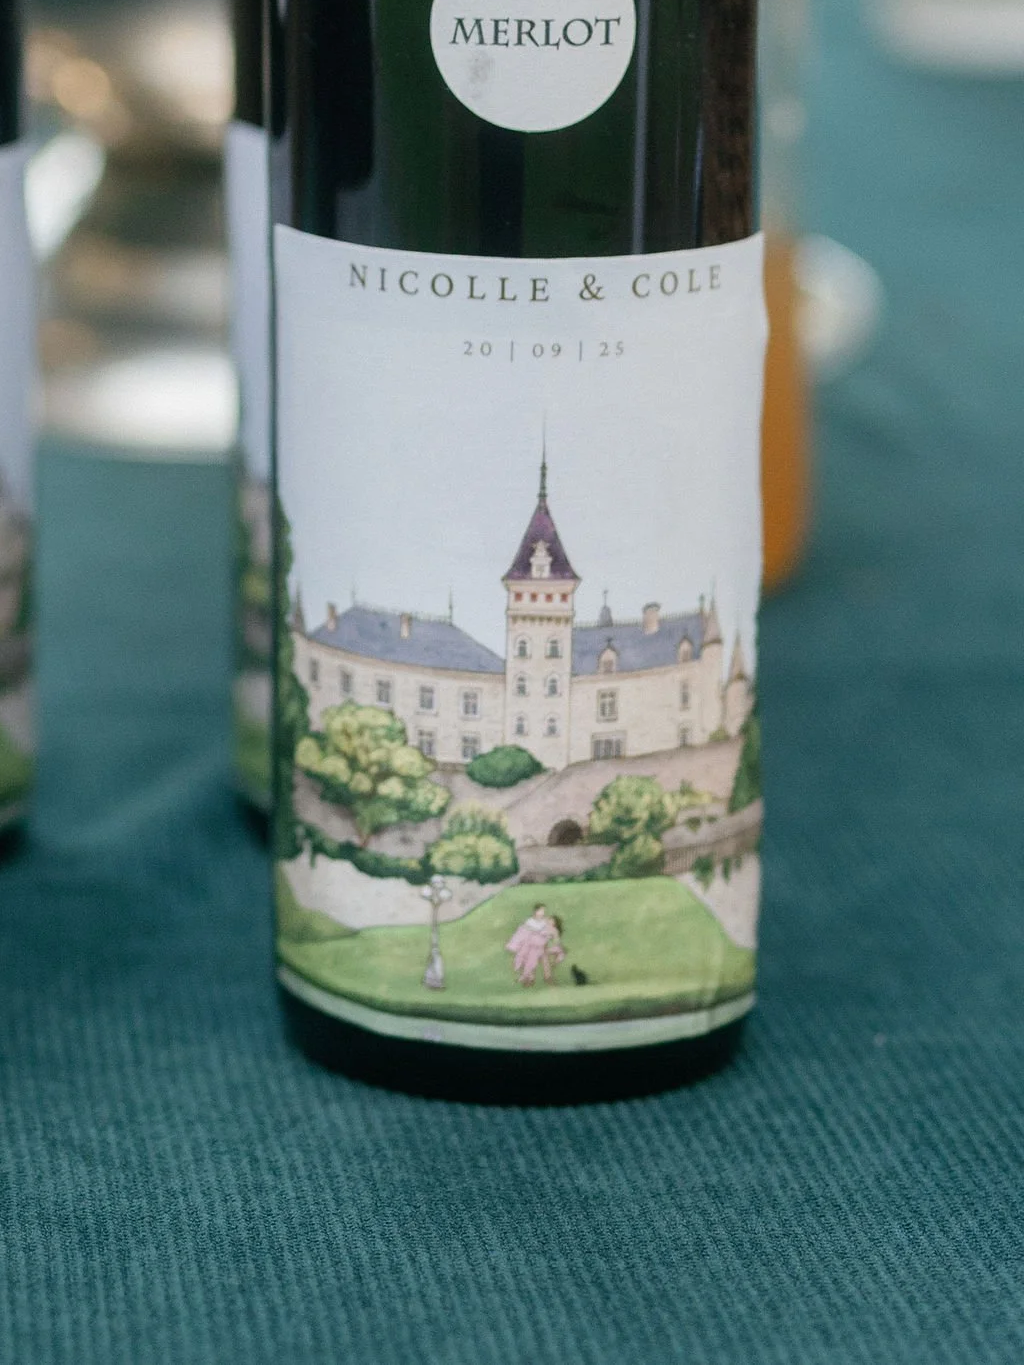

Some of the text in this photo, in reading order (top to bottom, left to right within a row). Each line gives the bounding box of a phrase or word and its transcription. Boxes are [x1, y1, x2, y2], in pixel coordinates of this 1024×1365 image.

[449, 16, 621, 51] MERLOT
[349, 263, 722, 303] NICOLLE & COLE
[463, 340, 493, 357] 20
[531, 341, 563, 358] 09
[599, 340, 625, 357] 25
